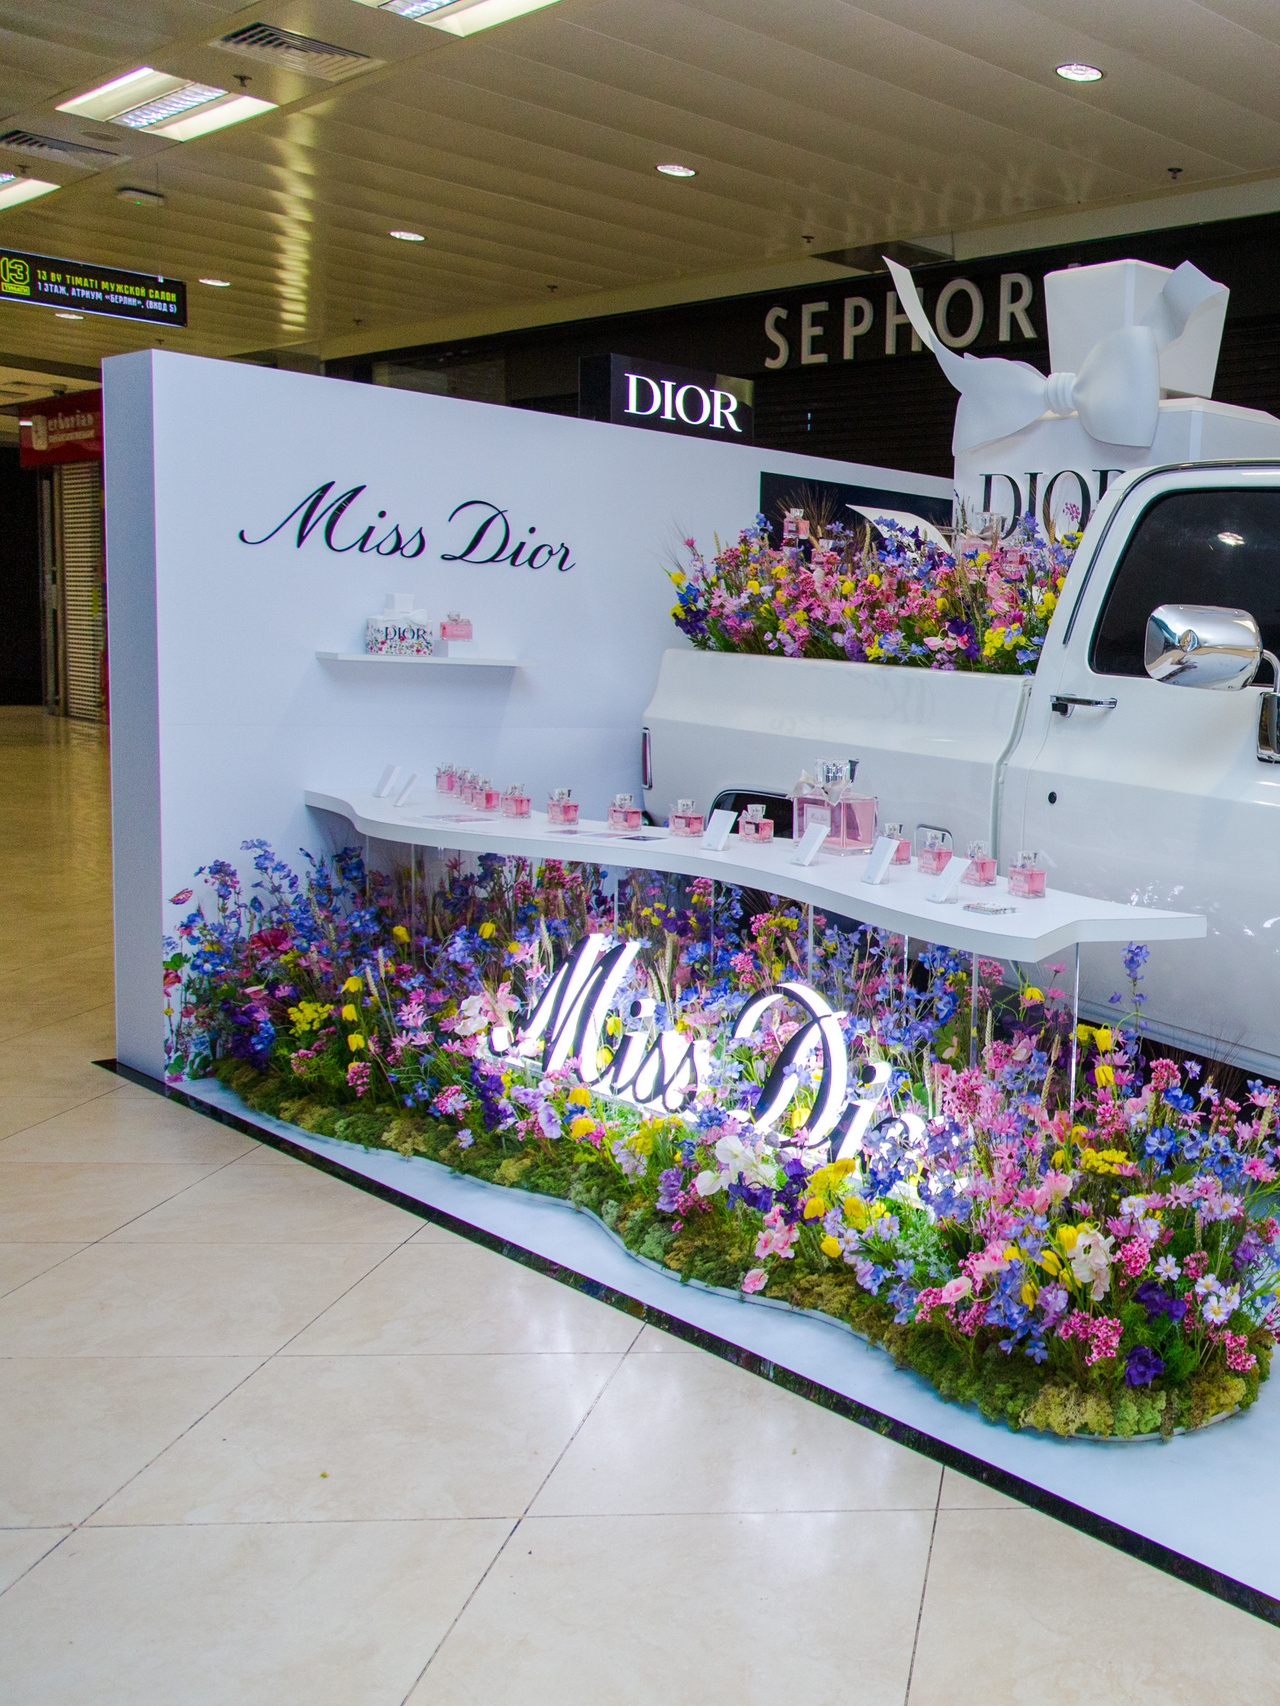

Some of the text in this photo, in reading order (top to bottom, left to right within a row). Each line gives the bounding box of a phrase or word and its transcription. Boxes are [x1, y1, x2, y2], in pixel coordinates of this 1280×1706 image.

[0, 257, 30, 285] 13
[37, 269, 48, 281] 13
[50, 271, 62, 284] BY
[101, 280, 146, 297] МУЖСКОЙ
[148, 288, 177, 303] САЛОН
[37, 281, 42, 291] 1
[71, 287, 103, 301] АТРИУМ
[145, 299, 169, 313] (ВХОД
[168, 302, 178, 314] 5)
[764, 272, 1038, 370] SEPHOR
[624, 372, 743, 433] DIOR
[238, 480, 577, 572] Miss Dior
[384, 626, 430, 644] DIOR
[489, 932, 710, 1113] Miss
